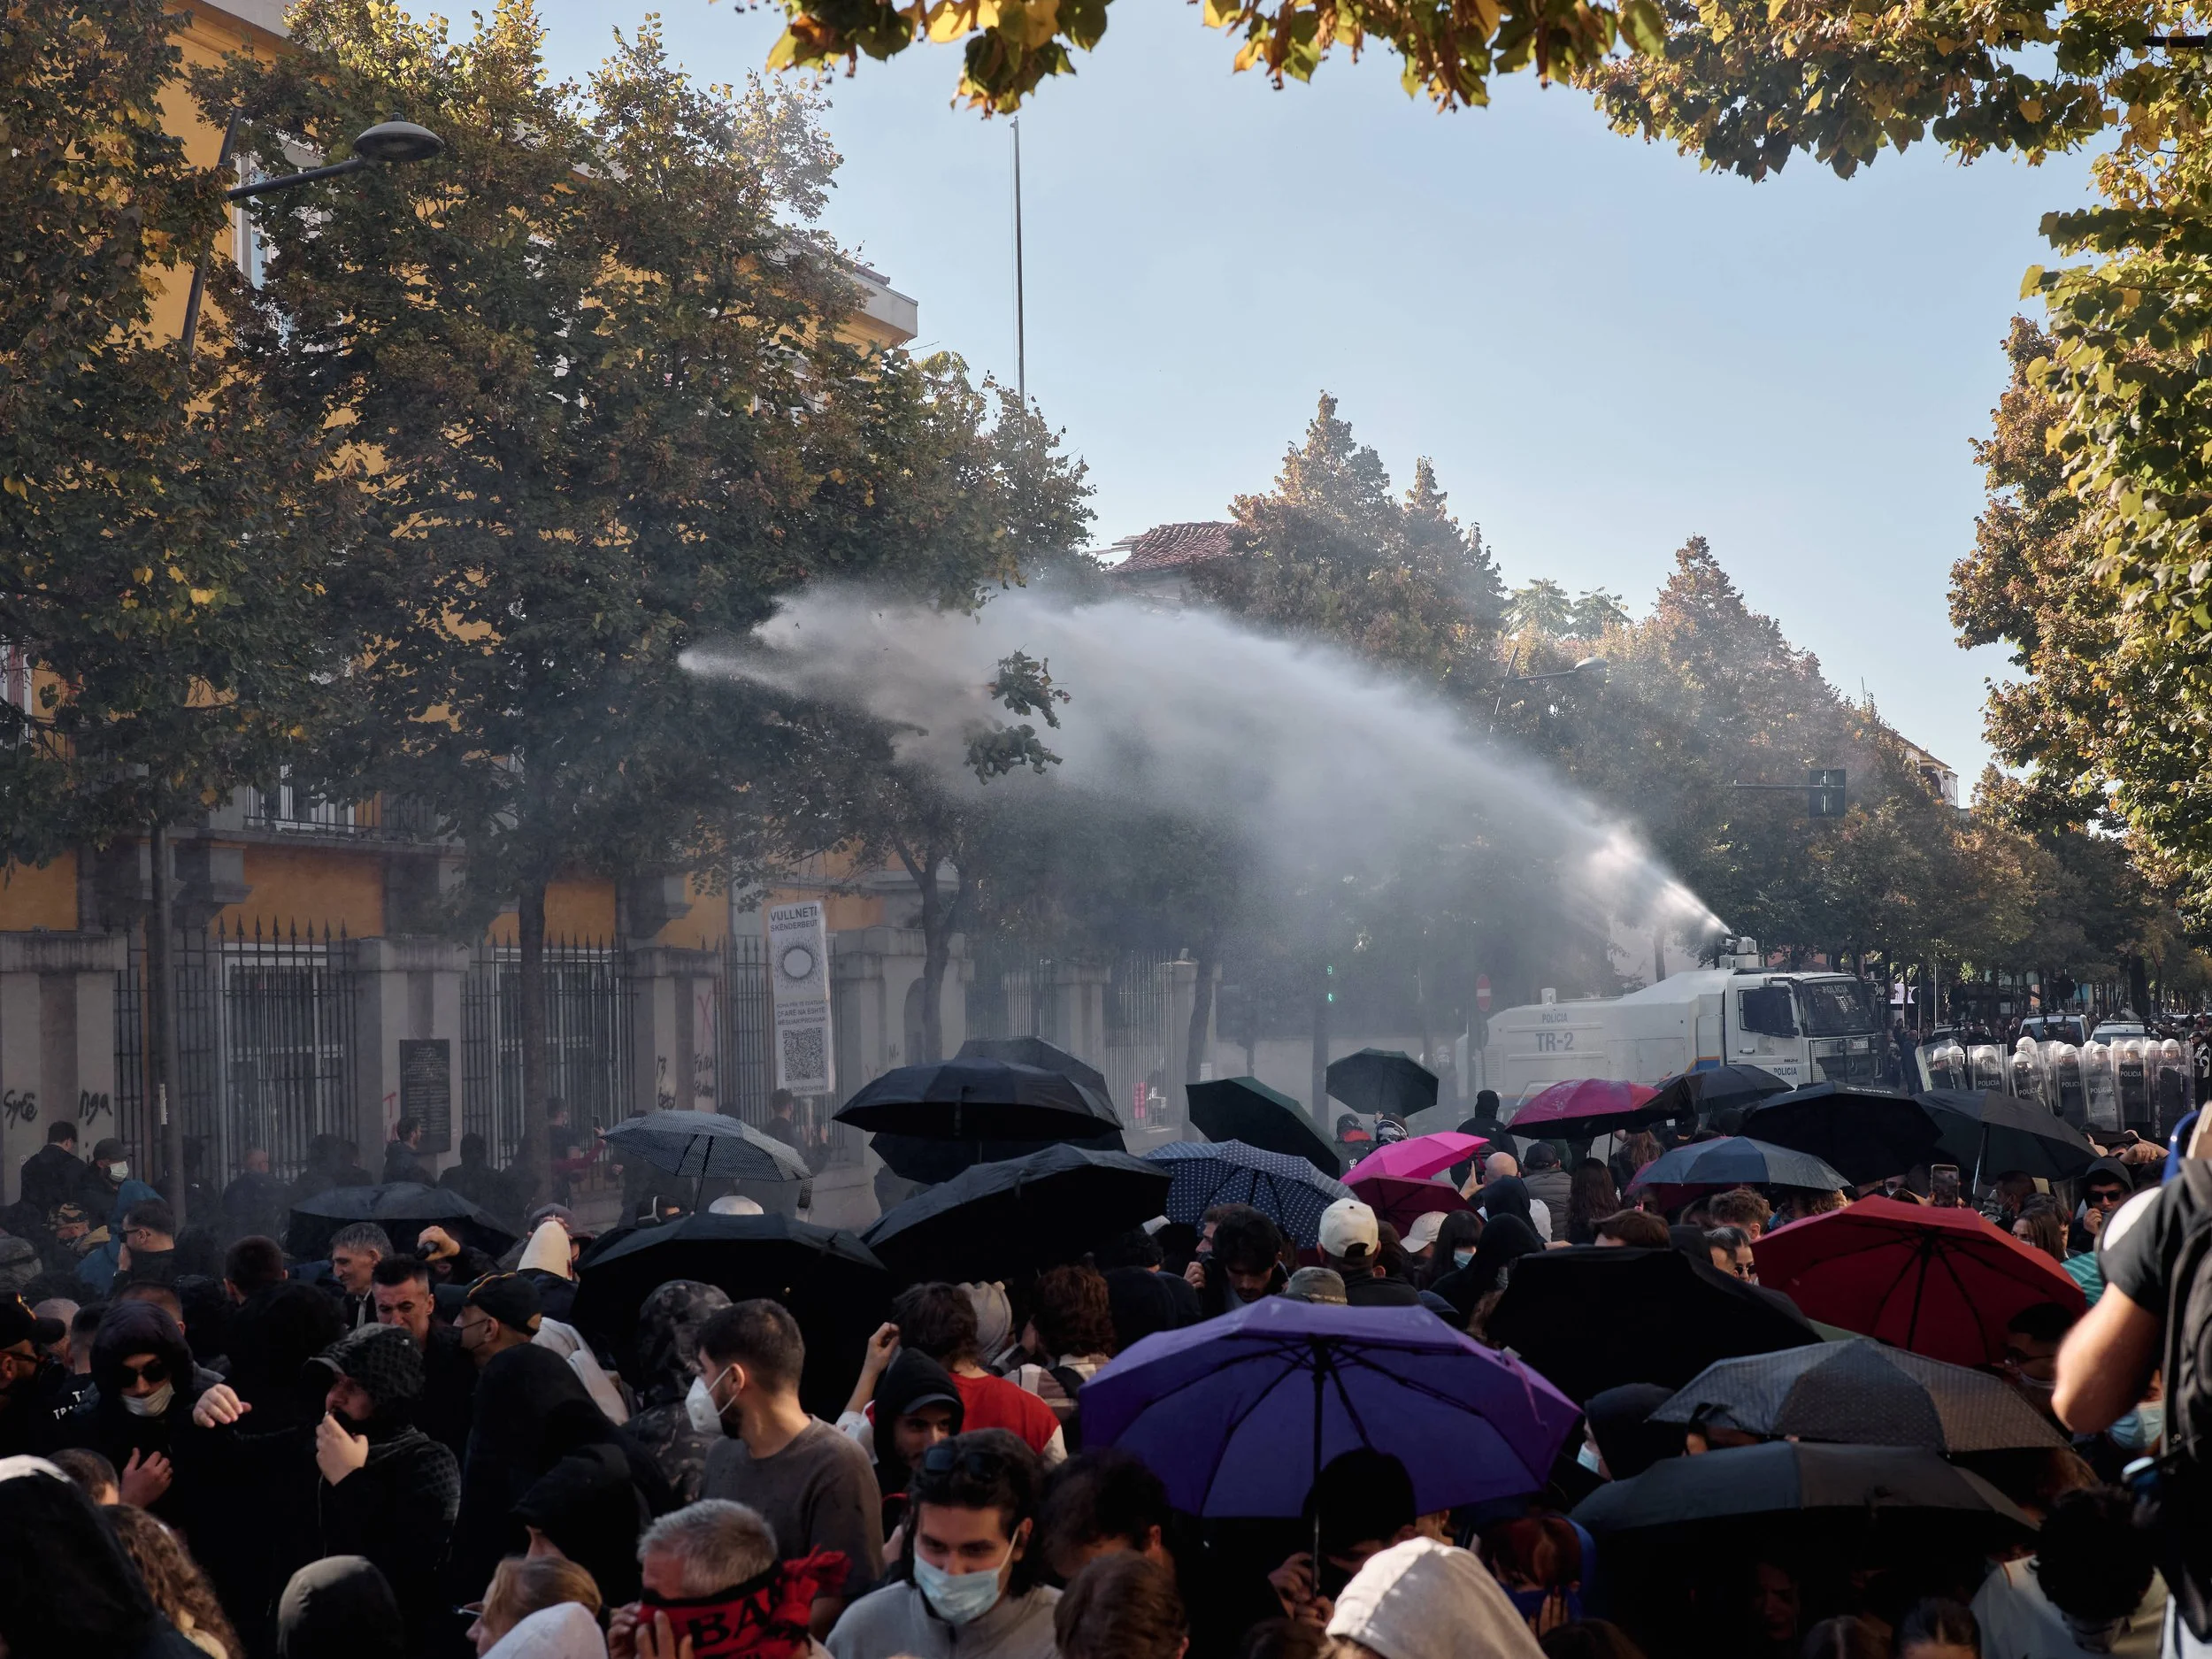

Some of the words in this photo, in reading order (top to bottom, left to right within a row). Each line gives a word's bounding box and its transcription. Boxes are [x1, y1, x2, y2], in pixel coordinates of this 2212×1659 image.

[770, 905, 818, 922] VULLNETI
[1541, 1011, 1568, 1023] POLICIA
[1535, 1032, 1574, 1051] TR-2
[1773, 1067, 1798, 1076] POLICIA
[1859, 1087, 1893, 1095] TOYOTA
[78, 1089, 112, 1125] nga
